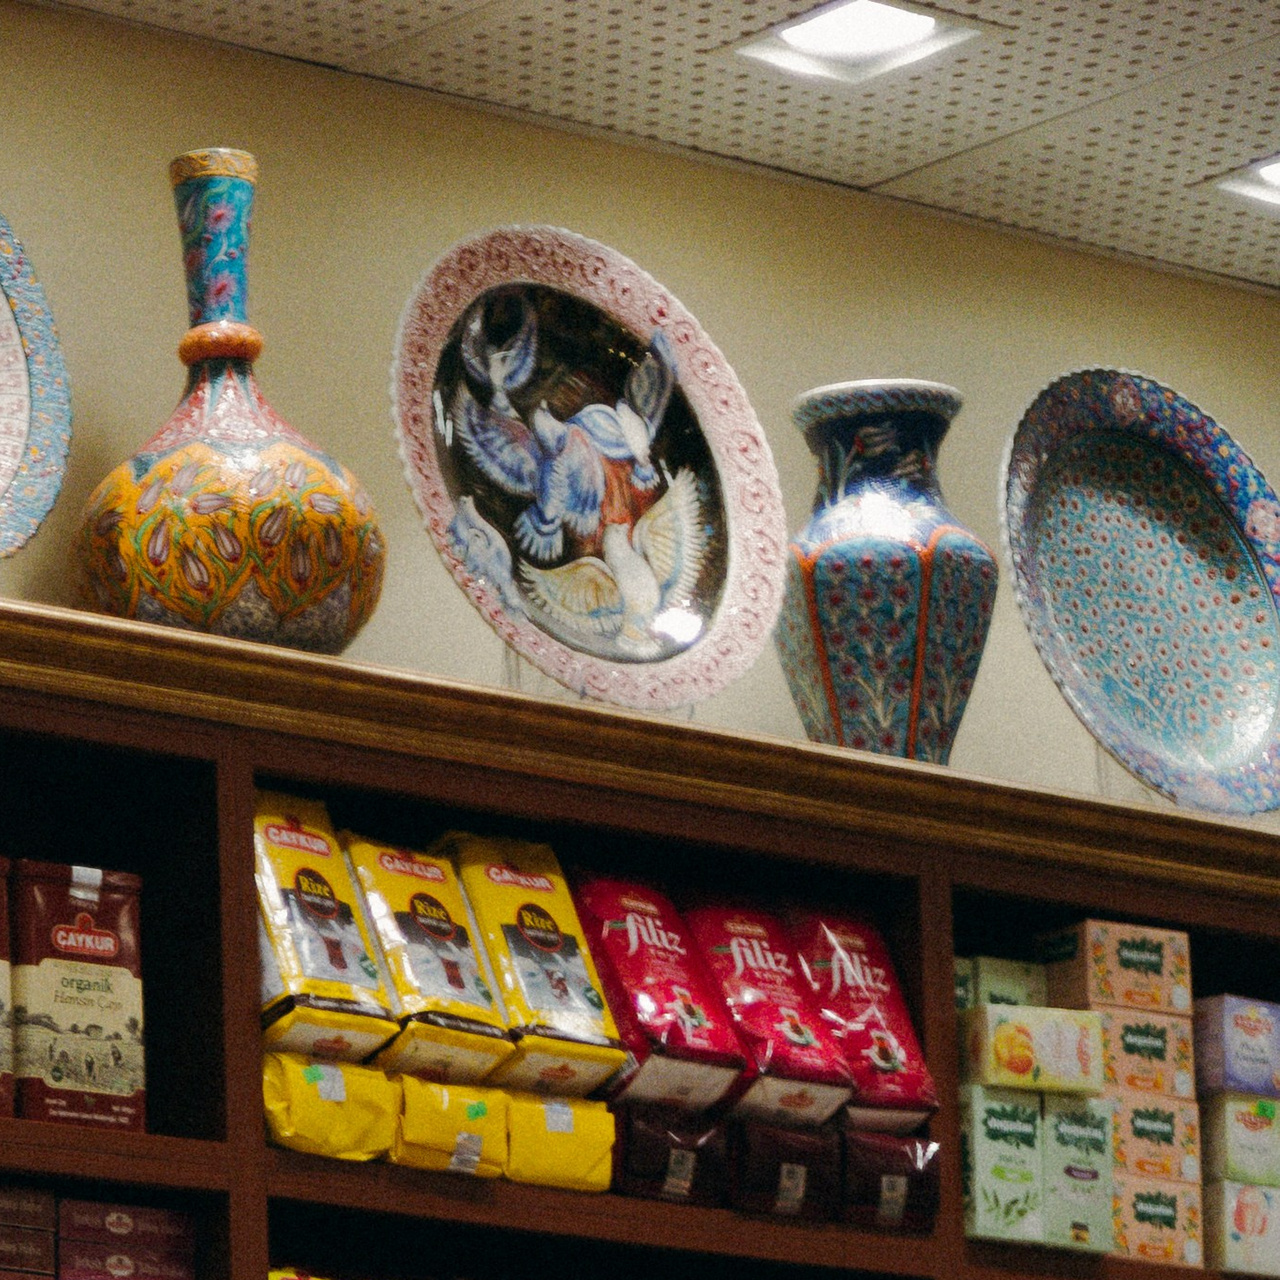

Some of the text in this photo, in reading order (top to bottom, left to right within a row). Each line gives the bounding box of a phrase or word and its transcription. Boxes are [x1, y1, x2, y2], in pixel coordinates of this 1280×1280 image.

[299, 876, 330, 898] Rize
[416, 901, 447, 920] Rize
[522, 911, 553, 930] Rize
[627, 912, 686, 956] filiz
[730, 937, 794, 978] filiz
[61, 976, 113, 993] organik
